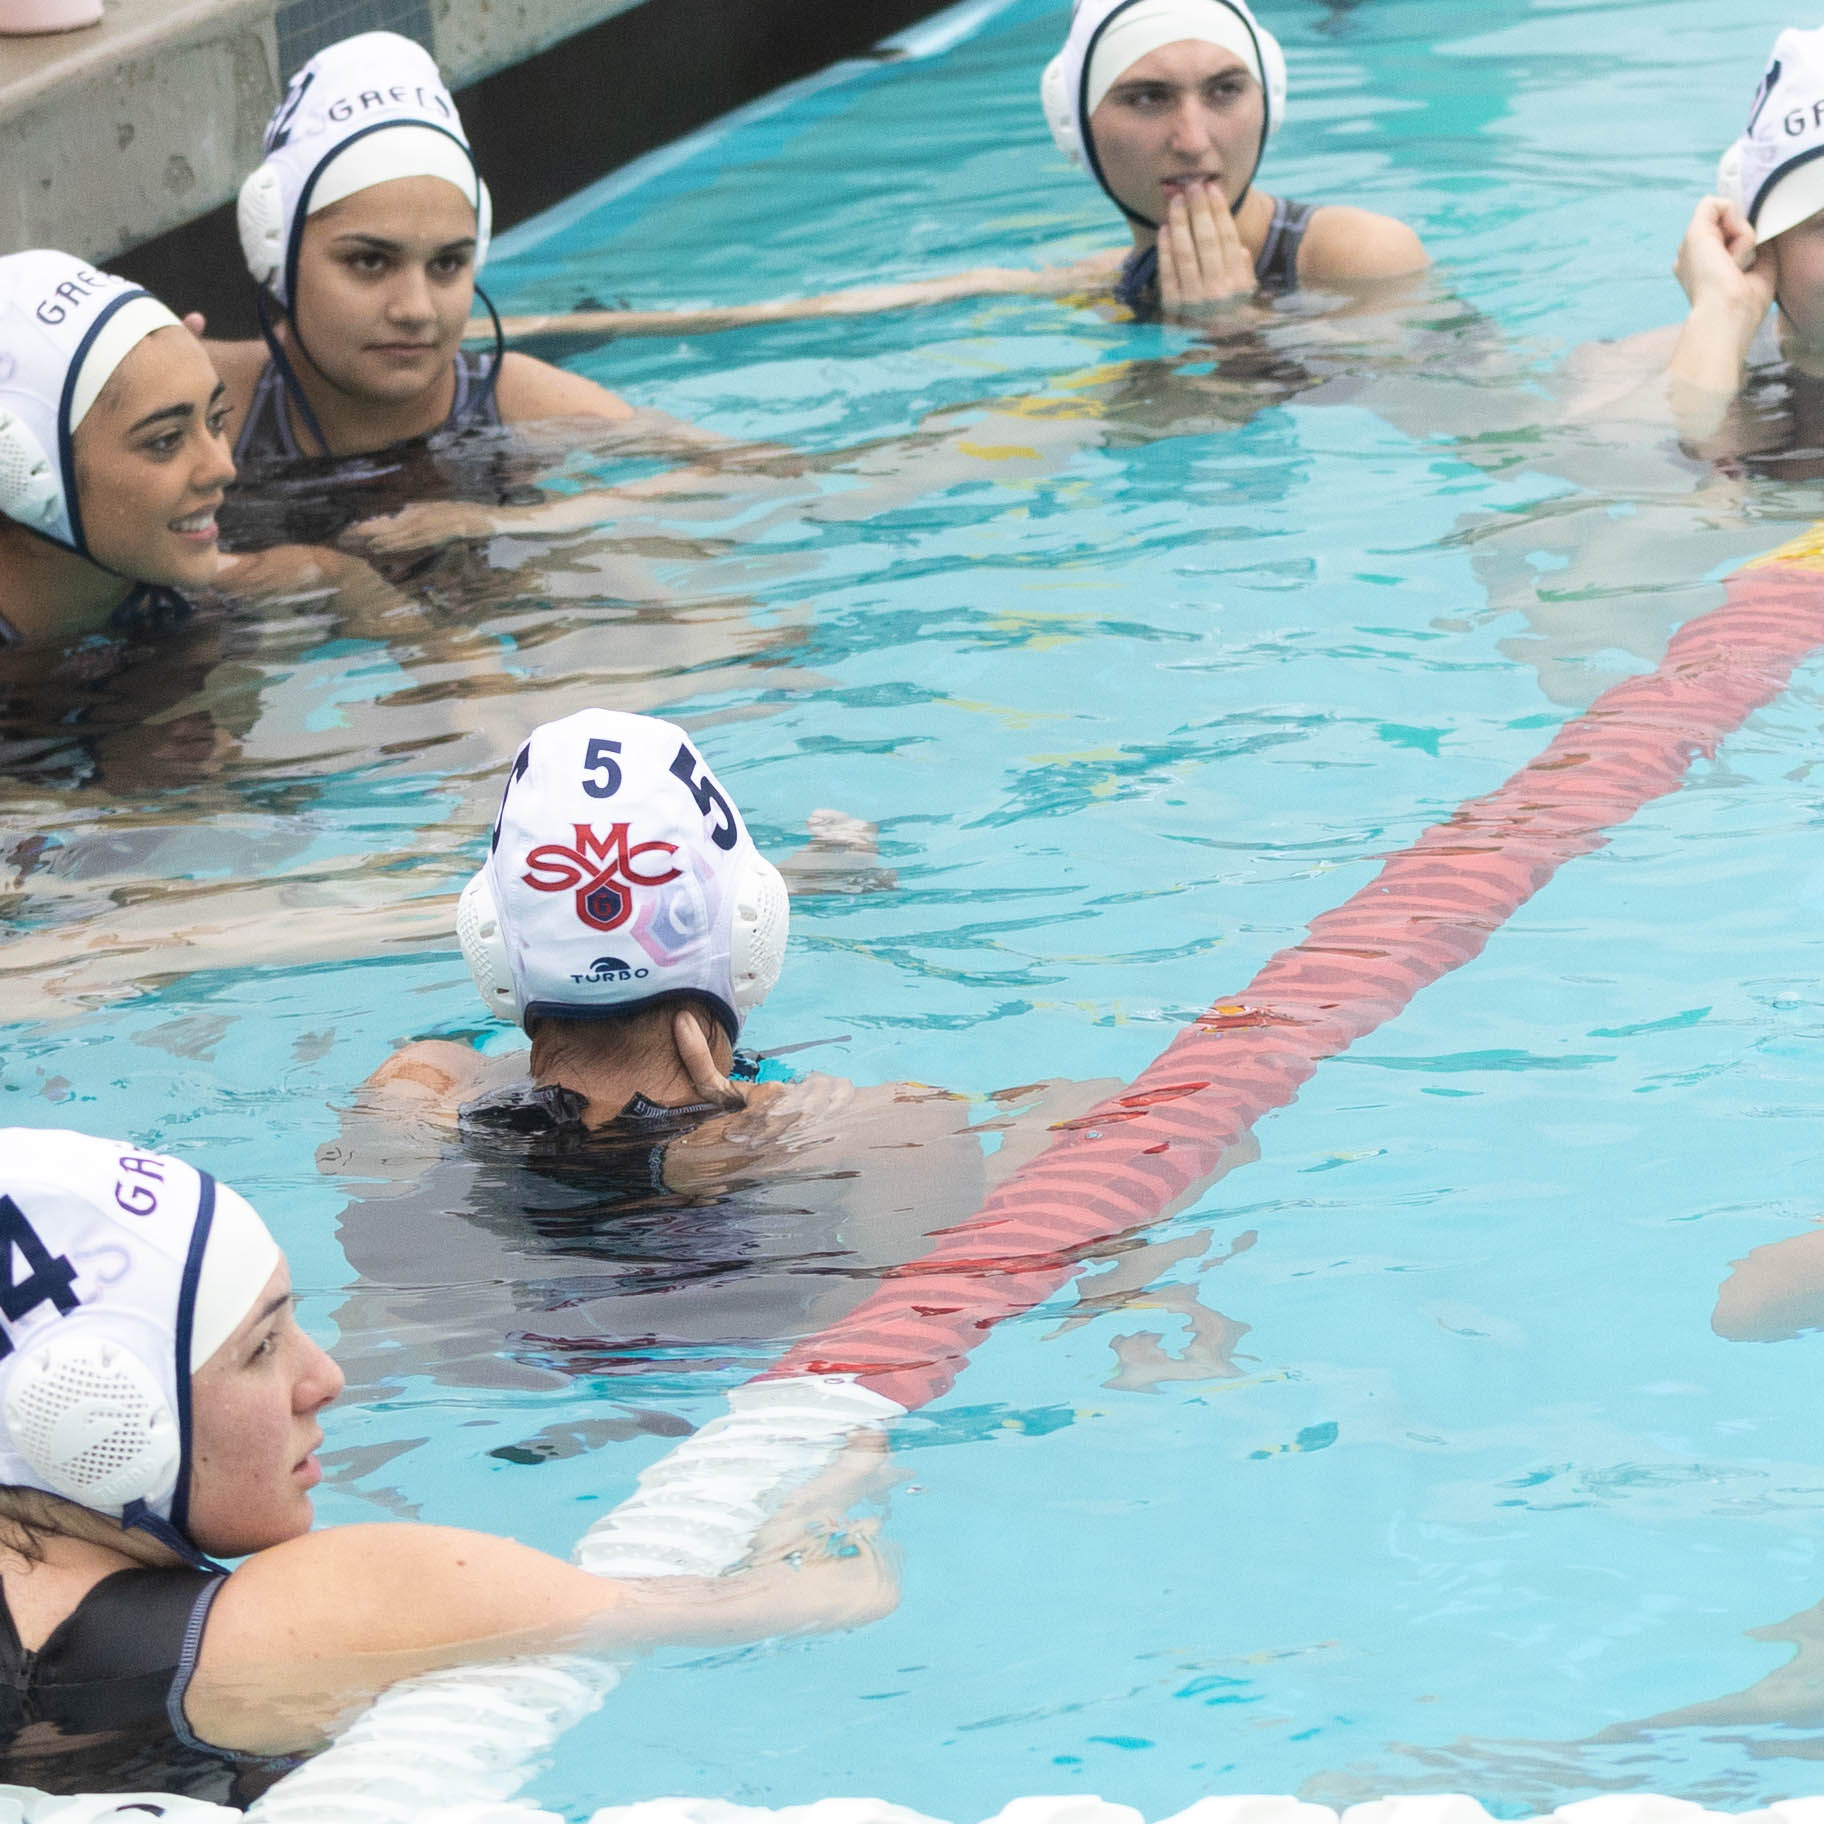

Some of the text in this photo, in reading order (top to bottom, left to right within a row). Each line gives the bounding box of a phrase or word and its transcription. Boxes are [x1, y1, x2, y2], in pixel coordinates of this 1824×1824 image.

[582, 738, 622, 799] 5
[669, 742, 738, 851] 5
[521, 822, 683, 893] SMC
[570, 967, 650, 985] TURBO
